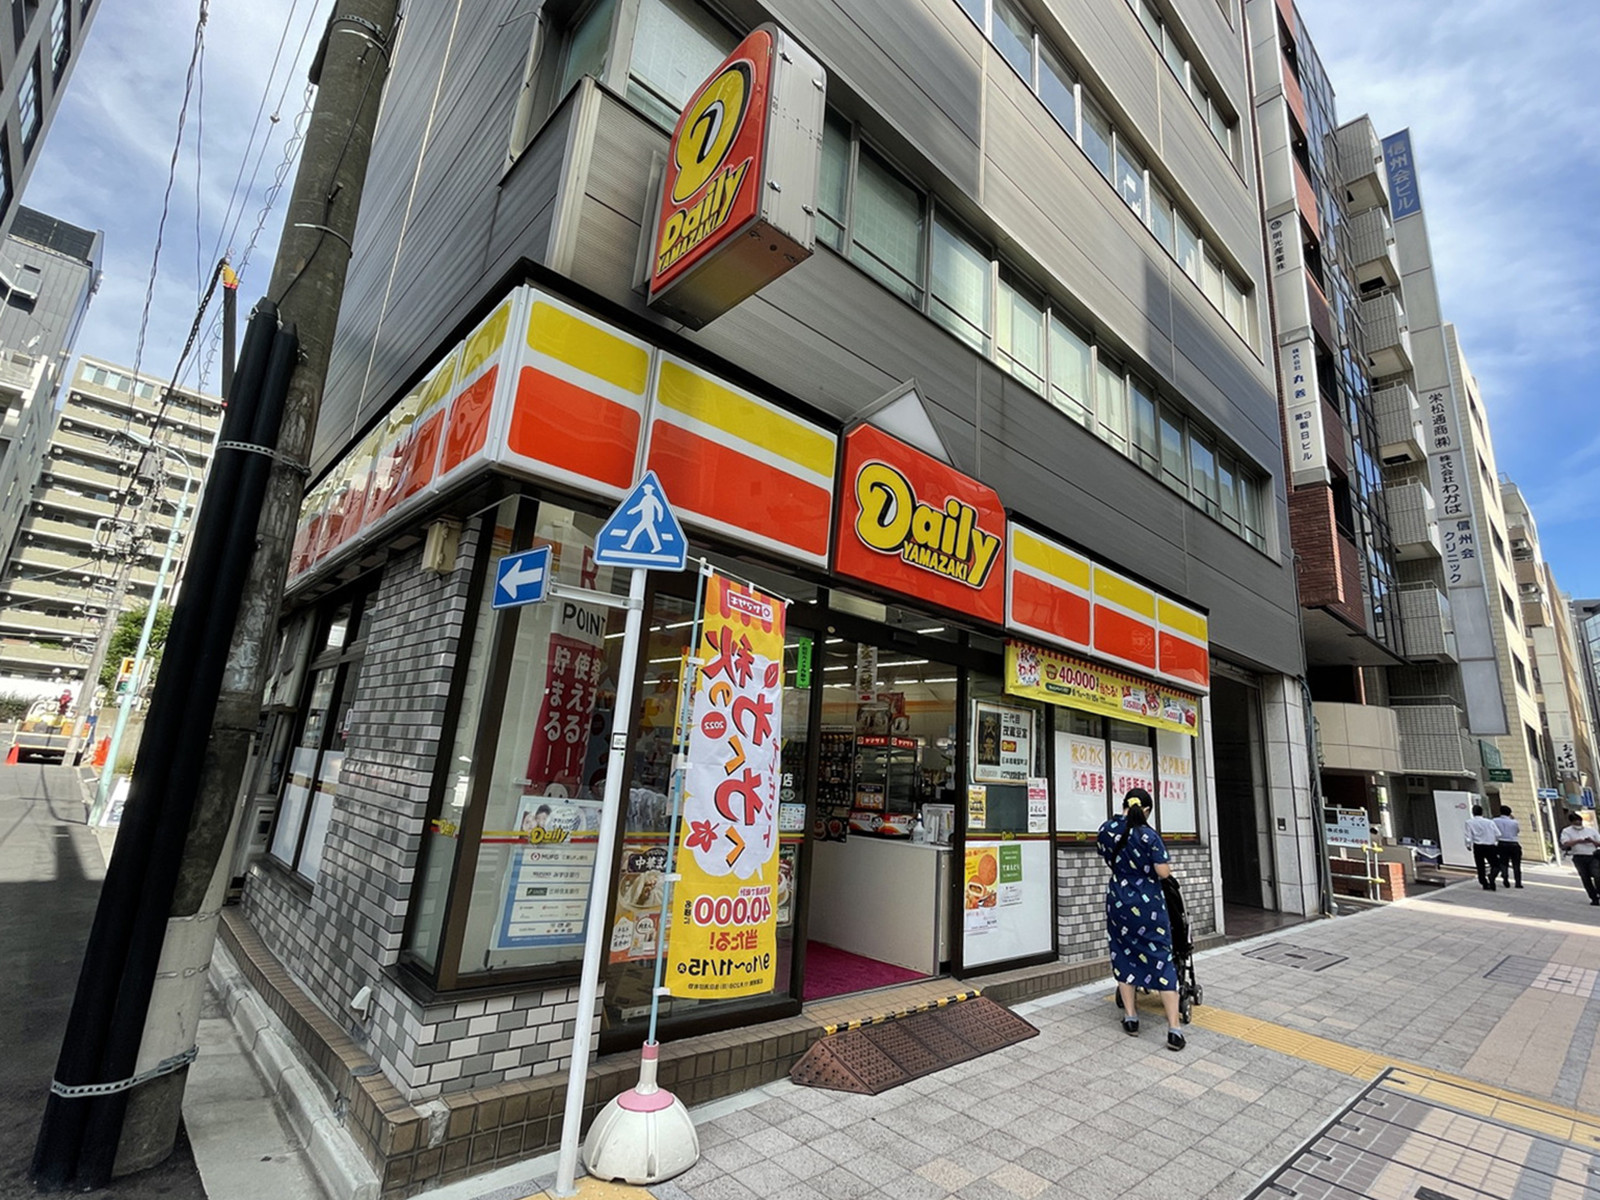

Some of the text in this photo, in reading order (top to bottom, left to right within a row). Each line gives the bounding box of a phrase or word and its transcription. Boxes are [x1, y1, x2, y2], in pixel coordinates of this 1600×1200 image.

[1387, 140, 1414, 212] 信州会ビル
[659, 158, 753, 252] Daily
[857, 461, 1001, 588] Daily
[1456, 519, 1475, 559] 信州会
[903, 540, 969, 580] YAMAZAKI
[1444, 530, 1462, 584] クリニック
[1059, 666, 1095, 691] 40,000
[1563, 743, 1575, 768] おそば
[530, 825, 570, 845] Daily
